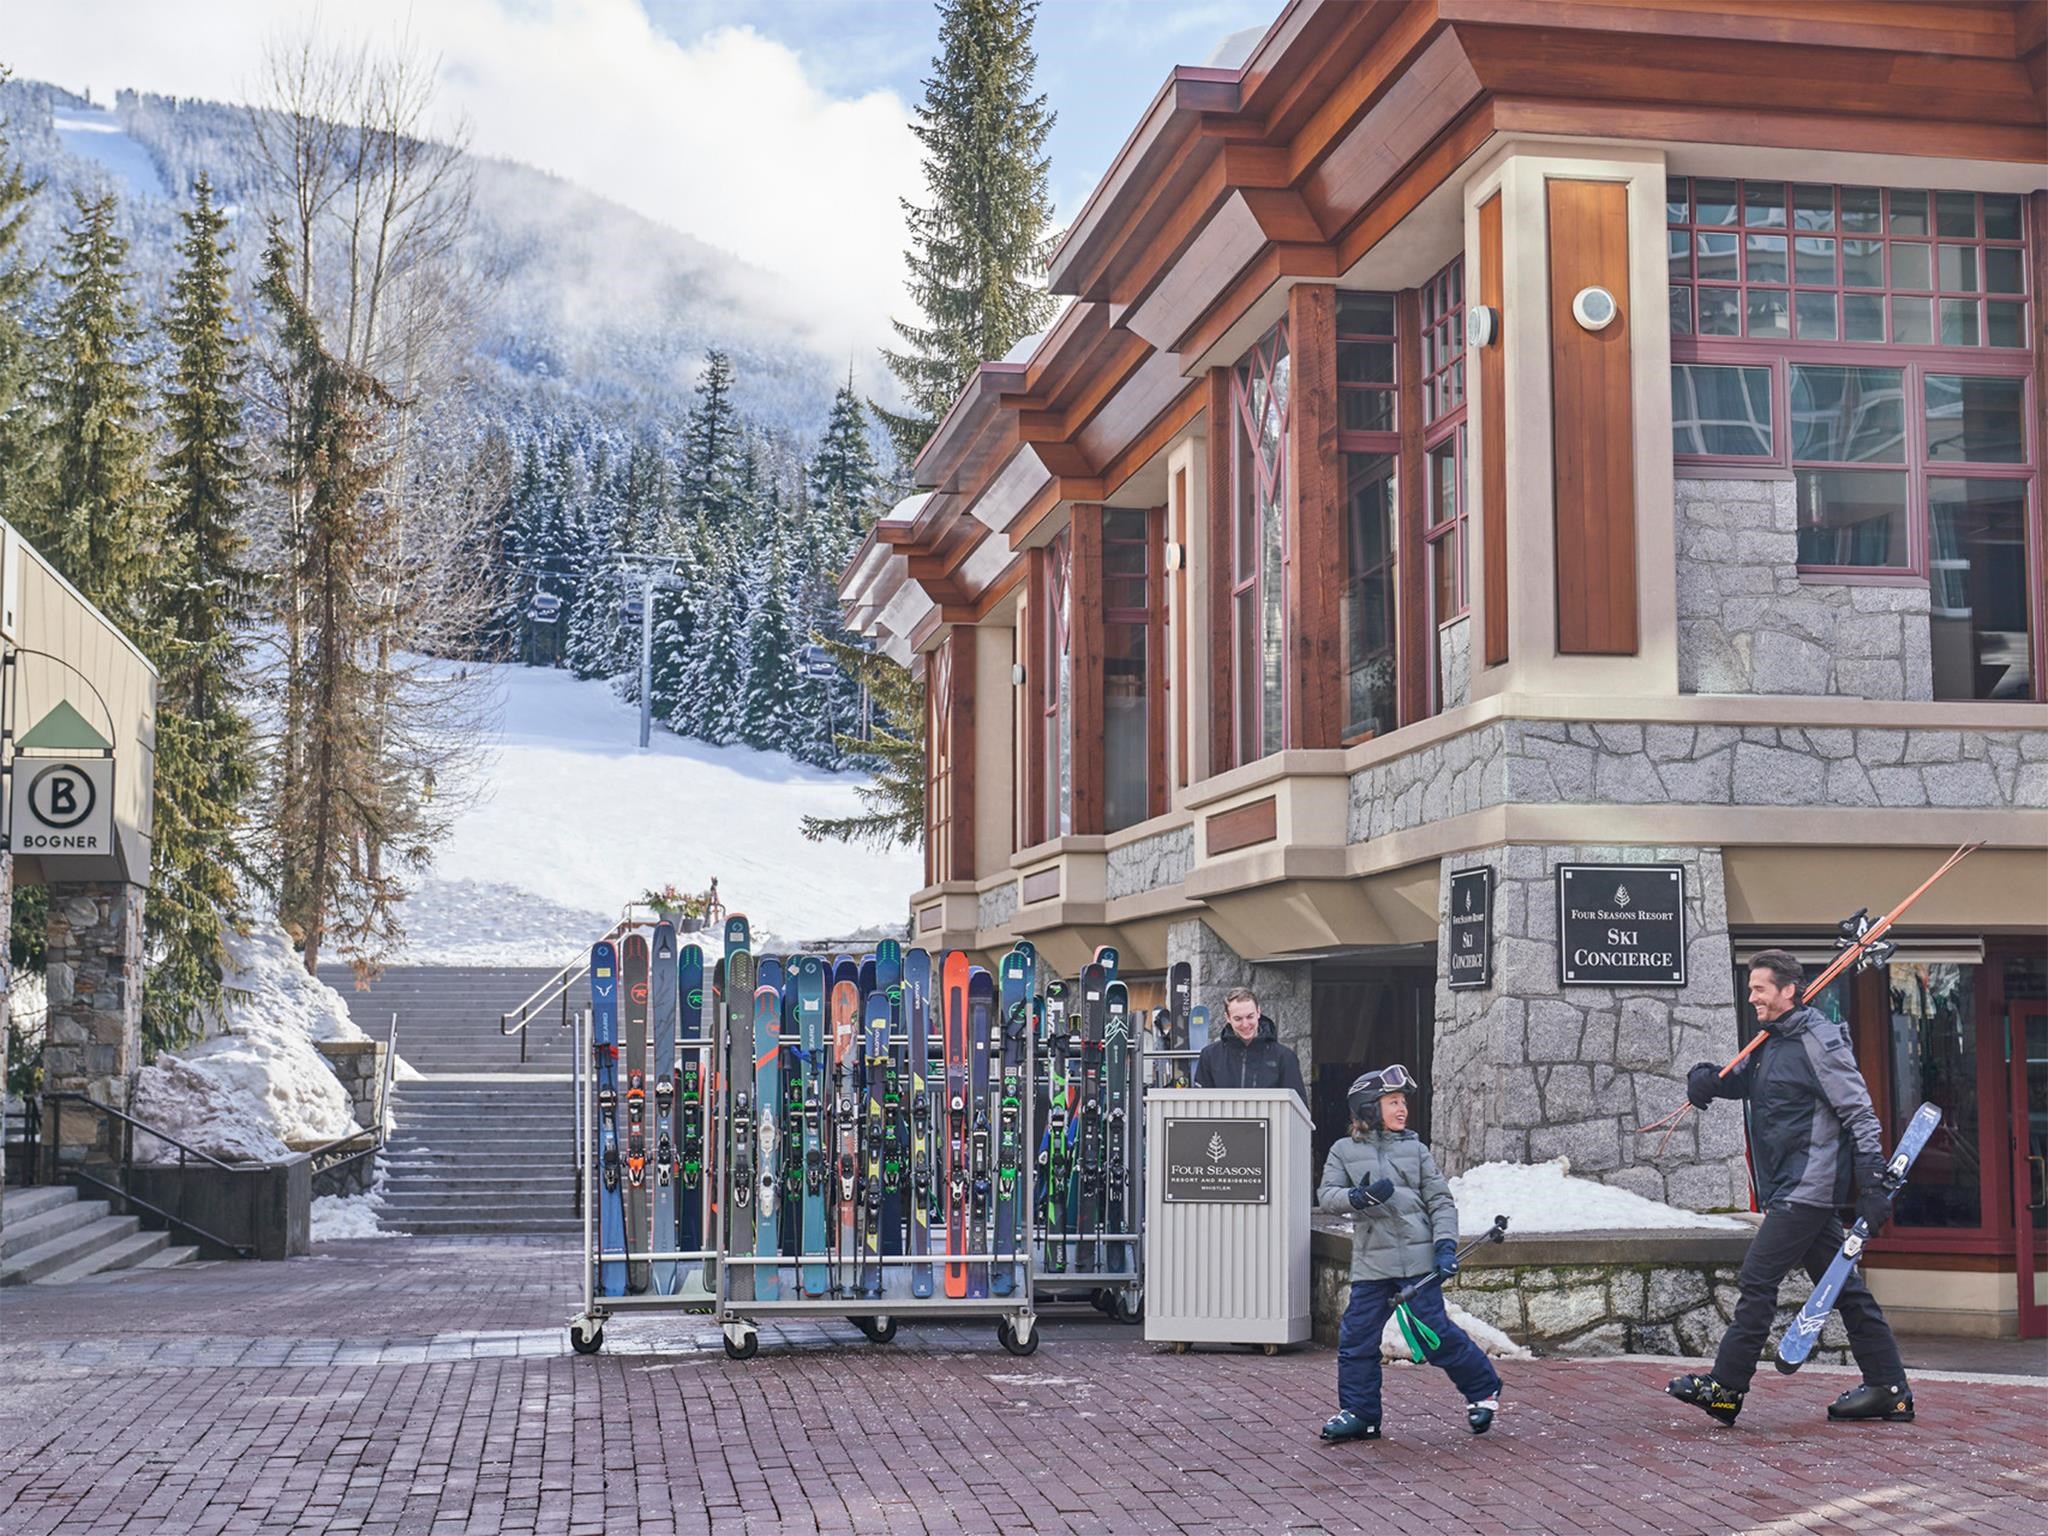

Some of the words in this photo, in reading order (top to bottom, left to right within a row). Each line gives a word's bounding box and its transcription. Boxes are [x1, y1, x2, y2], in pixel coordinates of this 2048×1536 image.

[51, 777, 77, 815] B
[23, 835, 98, 848] BOGNER
[1571, 909, 1595, 920] FOUR
[1597, 909, 1636, 920] SEASONS
[1638, 910, 1674, 921] RESORT
[1607, 928, 1638, 945] SKI
[1574, 948, 1673, 967] CONCIERGE
[1171, 1165, 1204, 1175] FOUR
[1206, 1165, 1262, 1176] SEASONS
